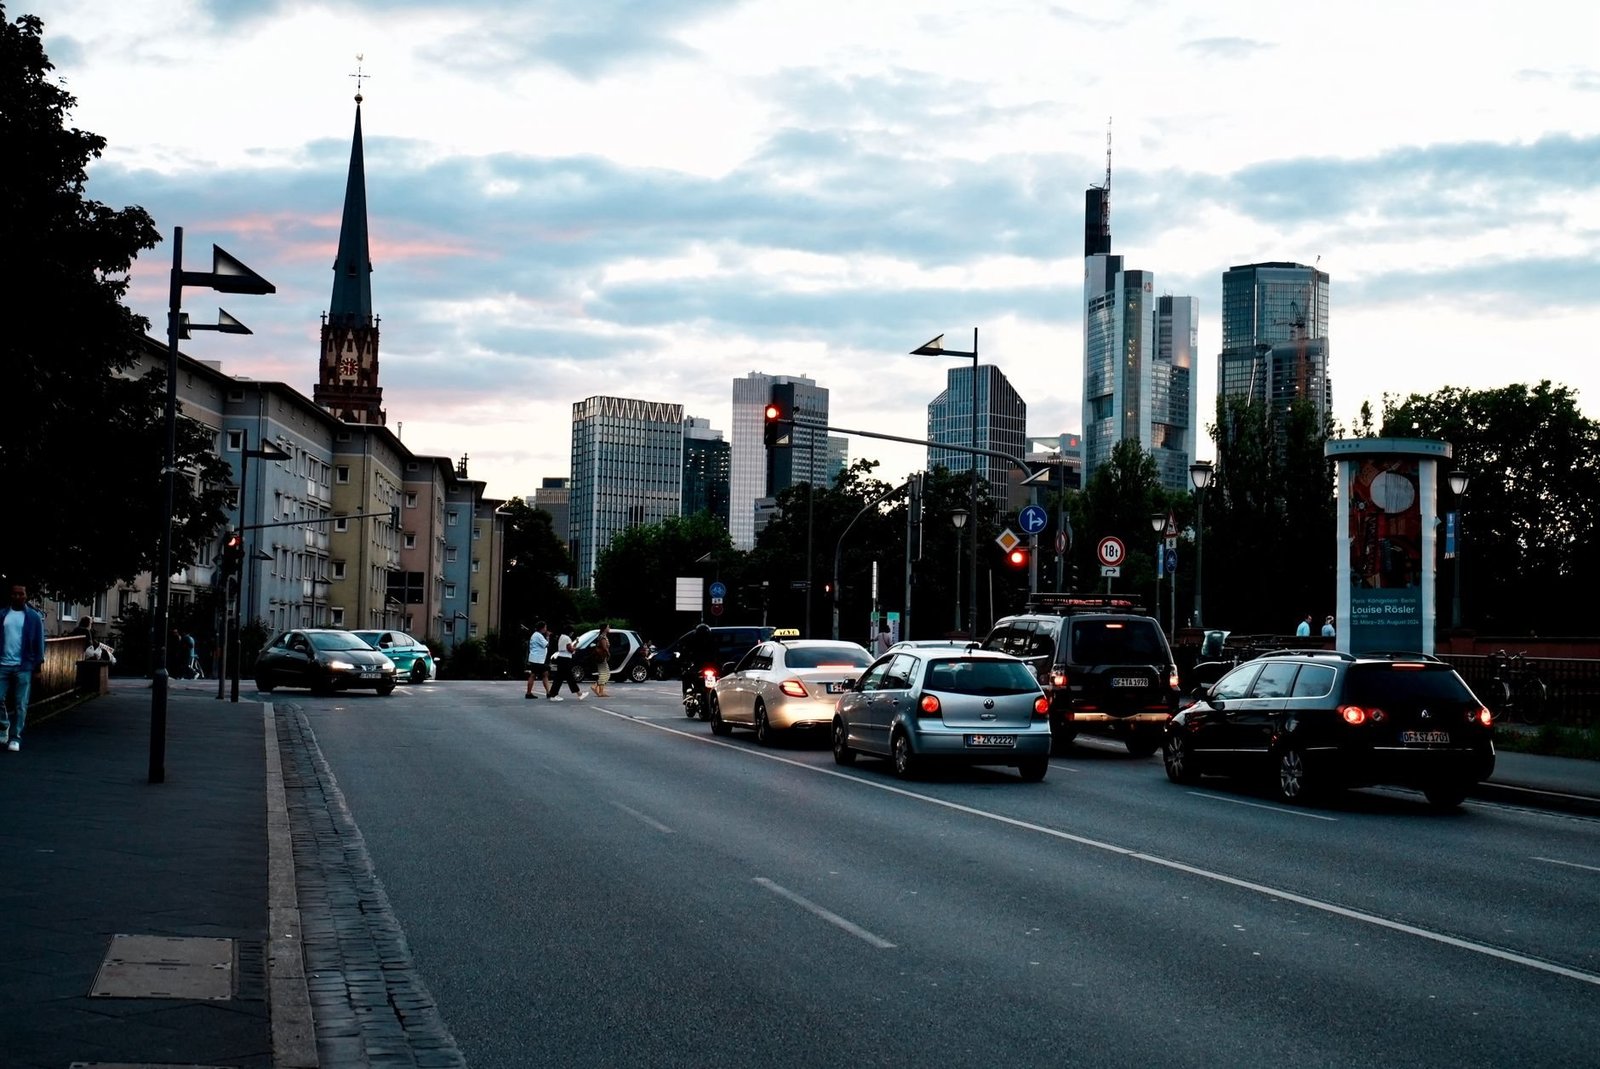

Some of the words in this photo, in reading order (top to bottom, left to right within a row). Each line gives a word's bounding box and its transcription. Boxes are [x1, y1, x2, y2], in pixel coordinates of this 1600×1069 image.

[1352, 605, 1382, 614] Louise
[1384, 605, 1415, 614] Rösler
[993, 736, 1013, 744] 2222
